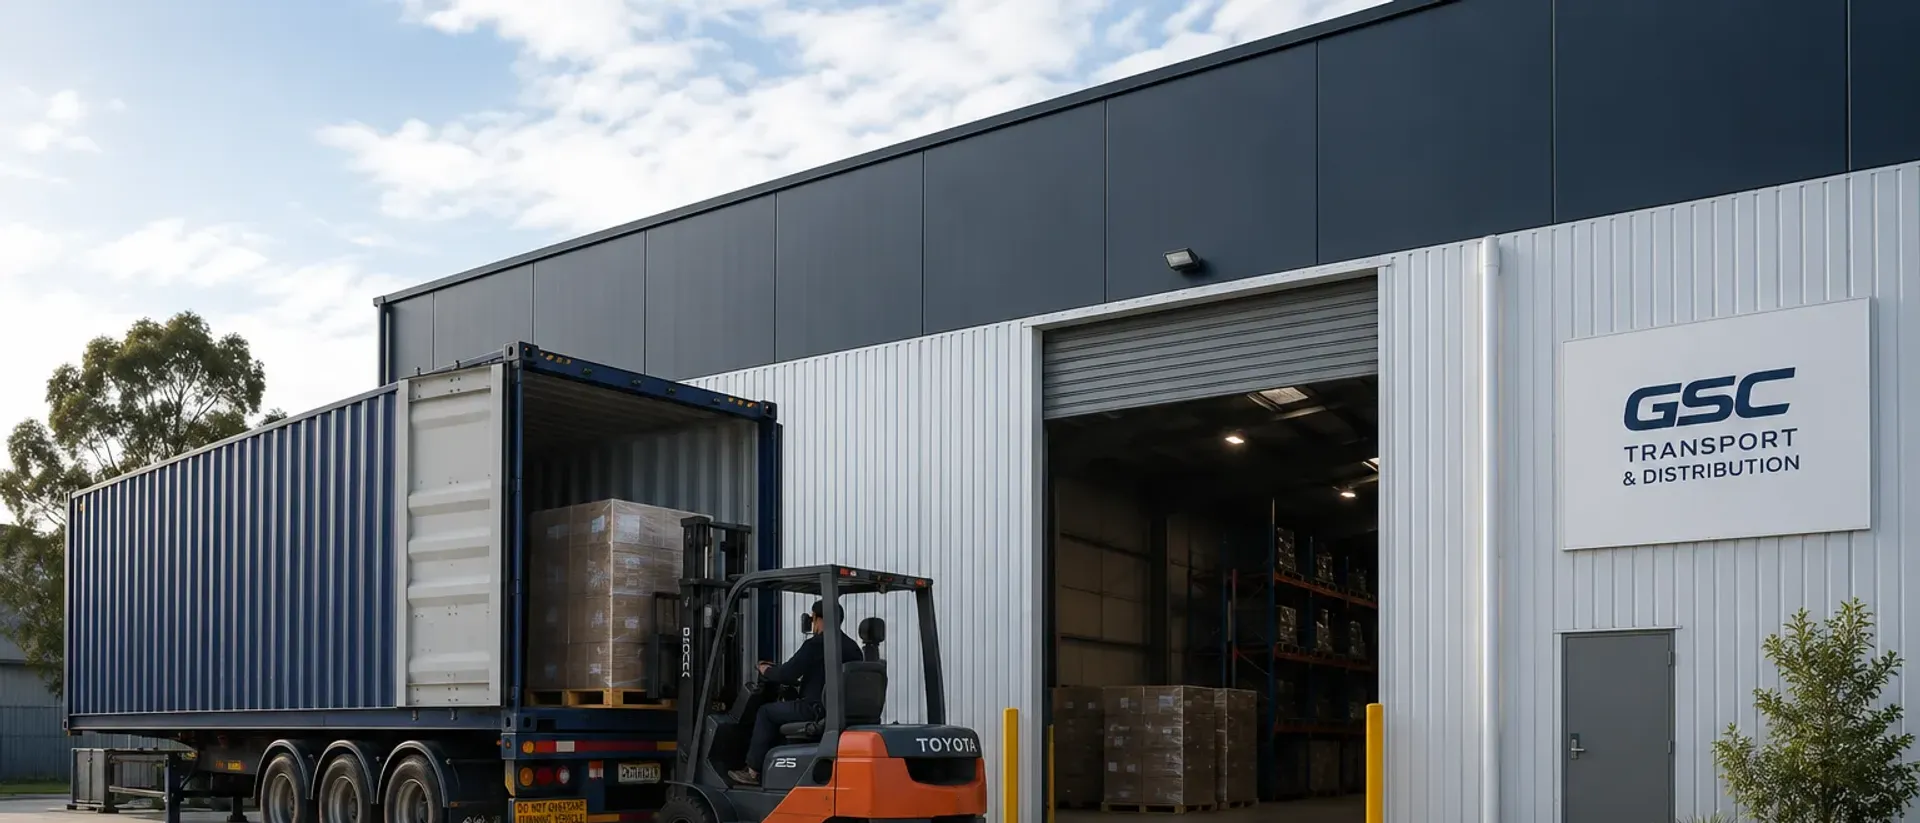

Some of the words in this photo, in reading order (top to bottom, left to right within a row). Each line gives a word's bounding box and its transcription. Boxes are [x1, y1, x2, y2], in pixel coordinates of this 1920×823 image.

[1624, 367, 1796, 432] GSC
[1624, 428, 1798, 463] TRANSPORT
[1623, 470, 1637, 487] &
[1643, 454, 1800, 485] DISTRIBUTION
[916, 737, 977, 753] TOYOTA
[774, 758, 797, 768] 25
